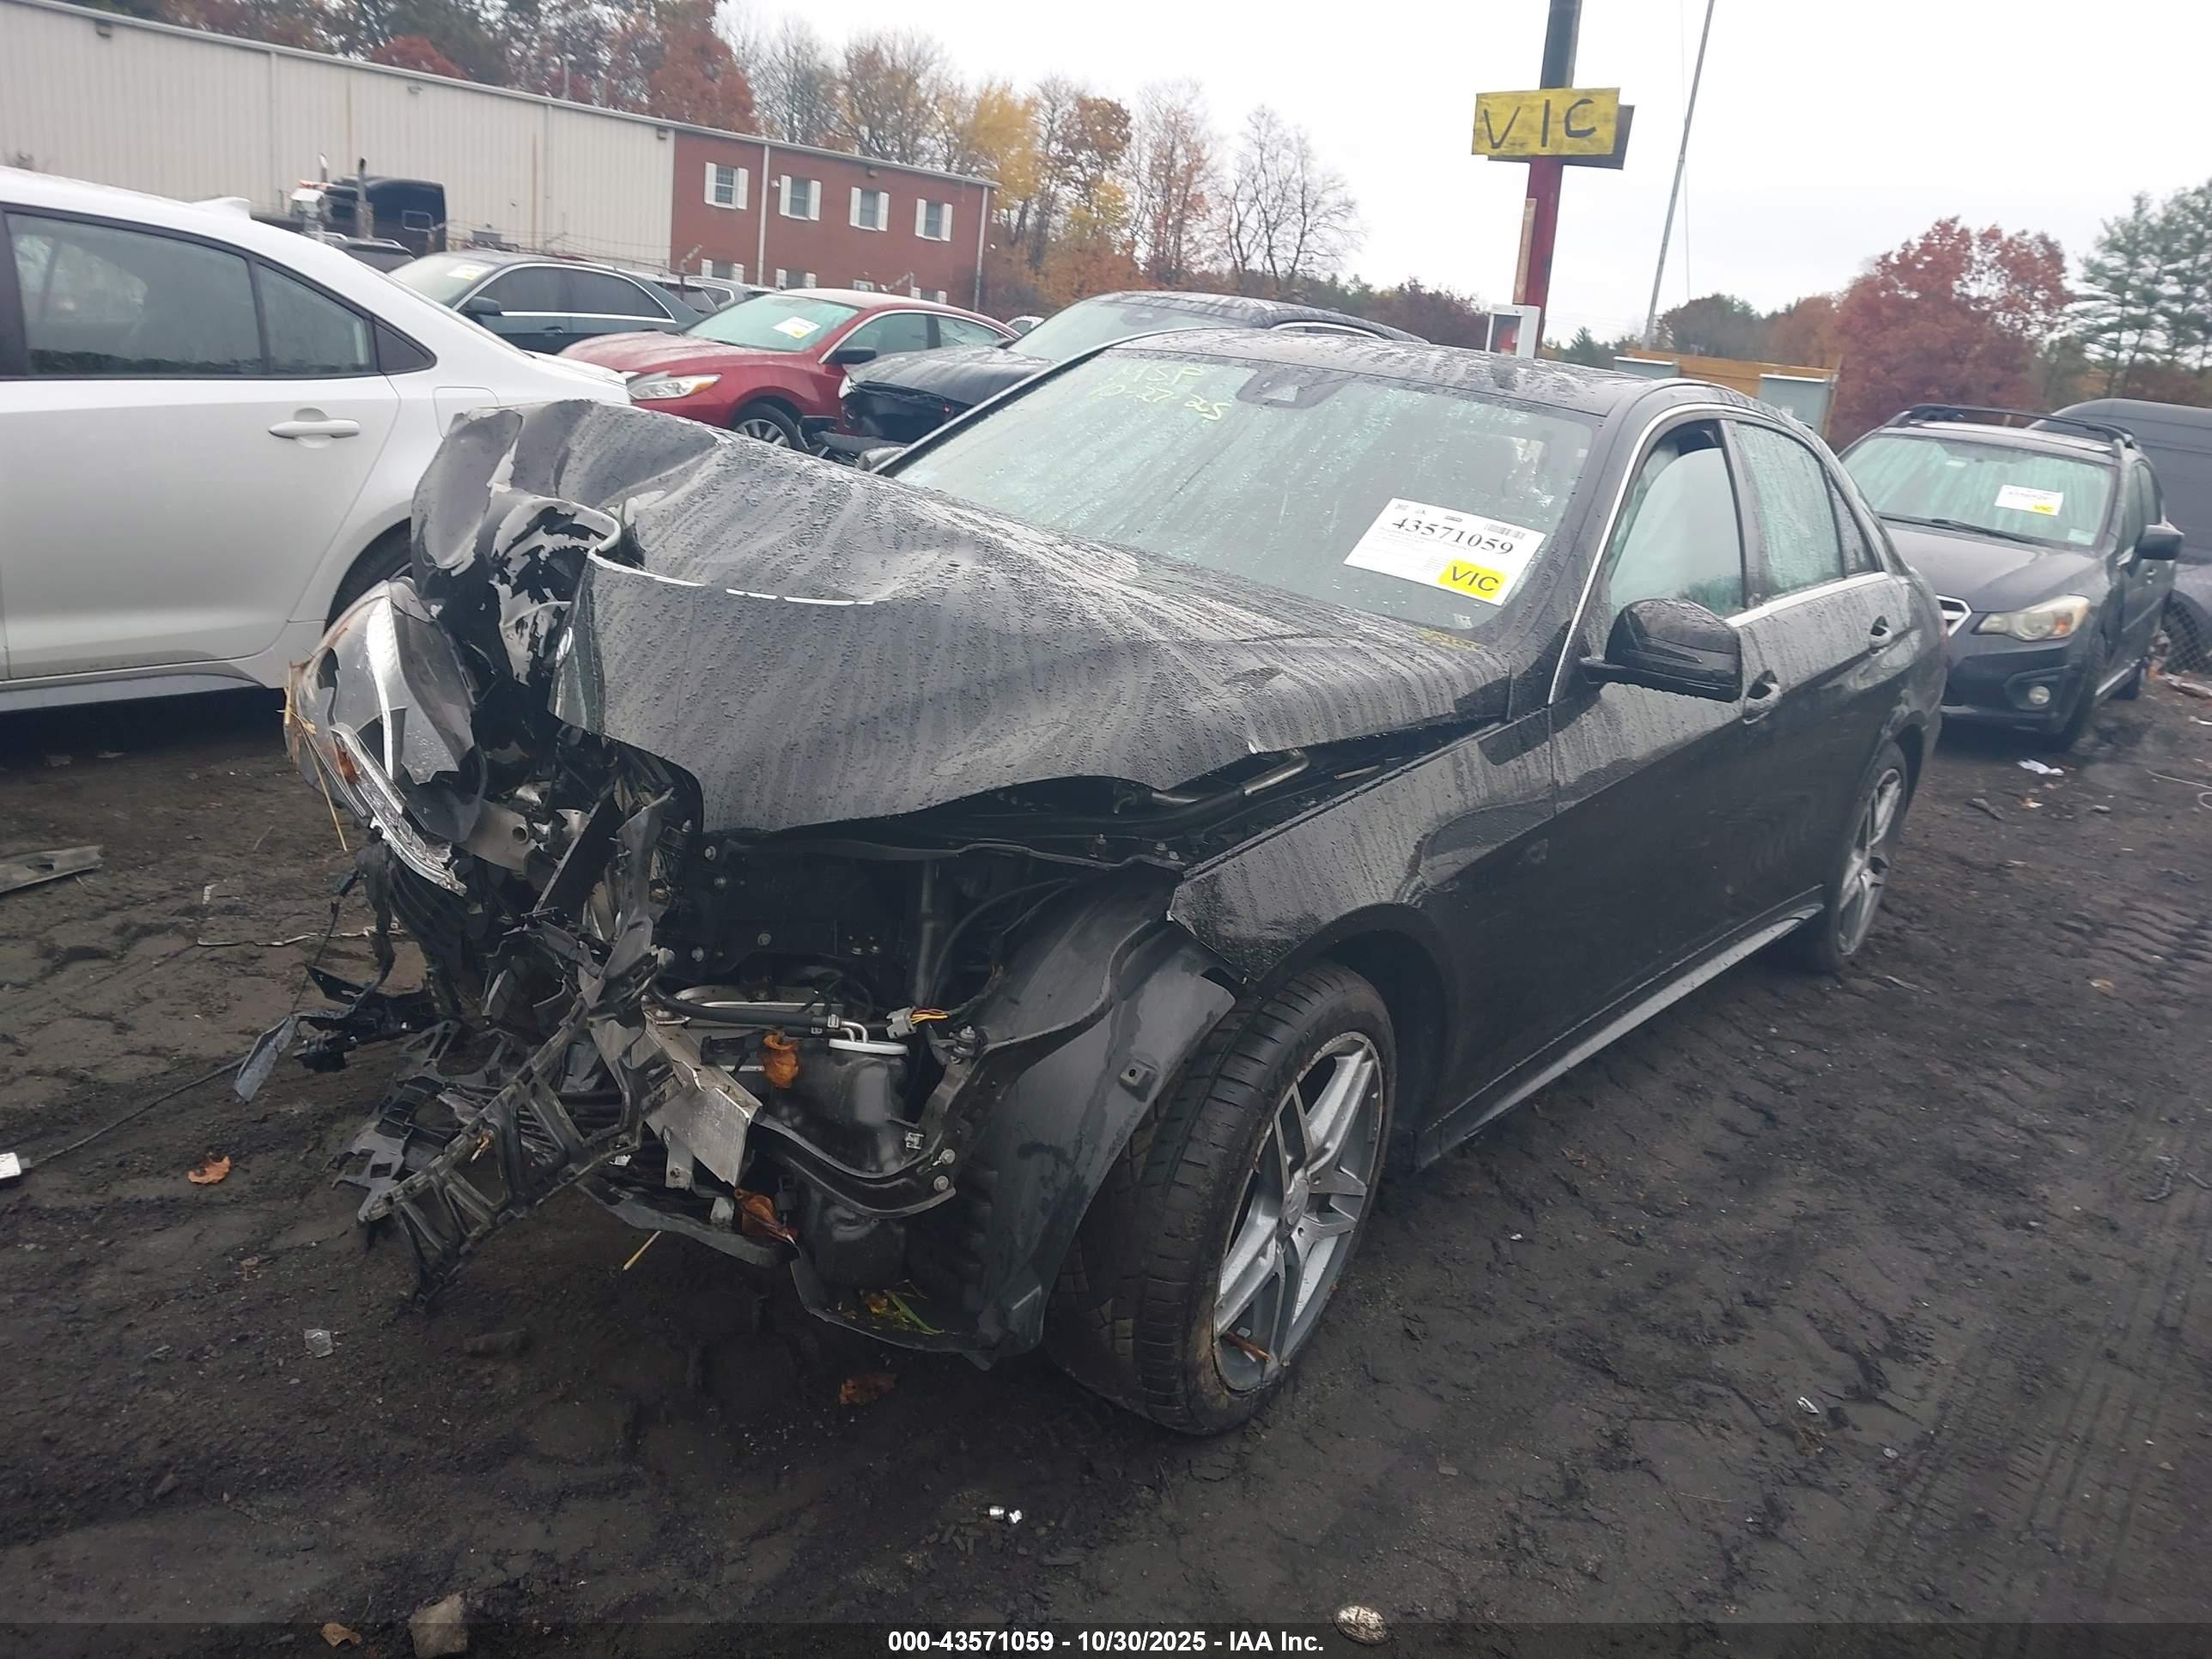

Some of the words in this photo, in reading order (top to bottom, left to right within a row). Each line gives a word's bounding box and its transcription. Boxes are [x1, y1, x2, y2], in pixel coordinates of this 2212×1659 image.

[1483, 99, 1596, 149] VIC
[1391, 517, 1514, 556] 43571059
[1450, 566, 1500, 592] VIC
